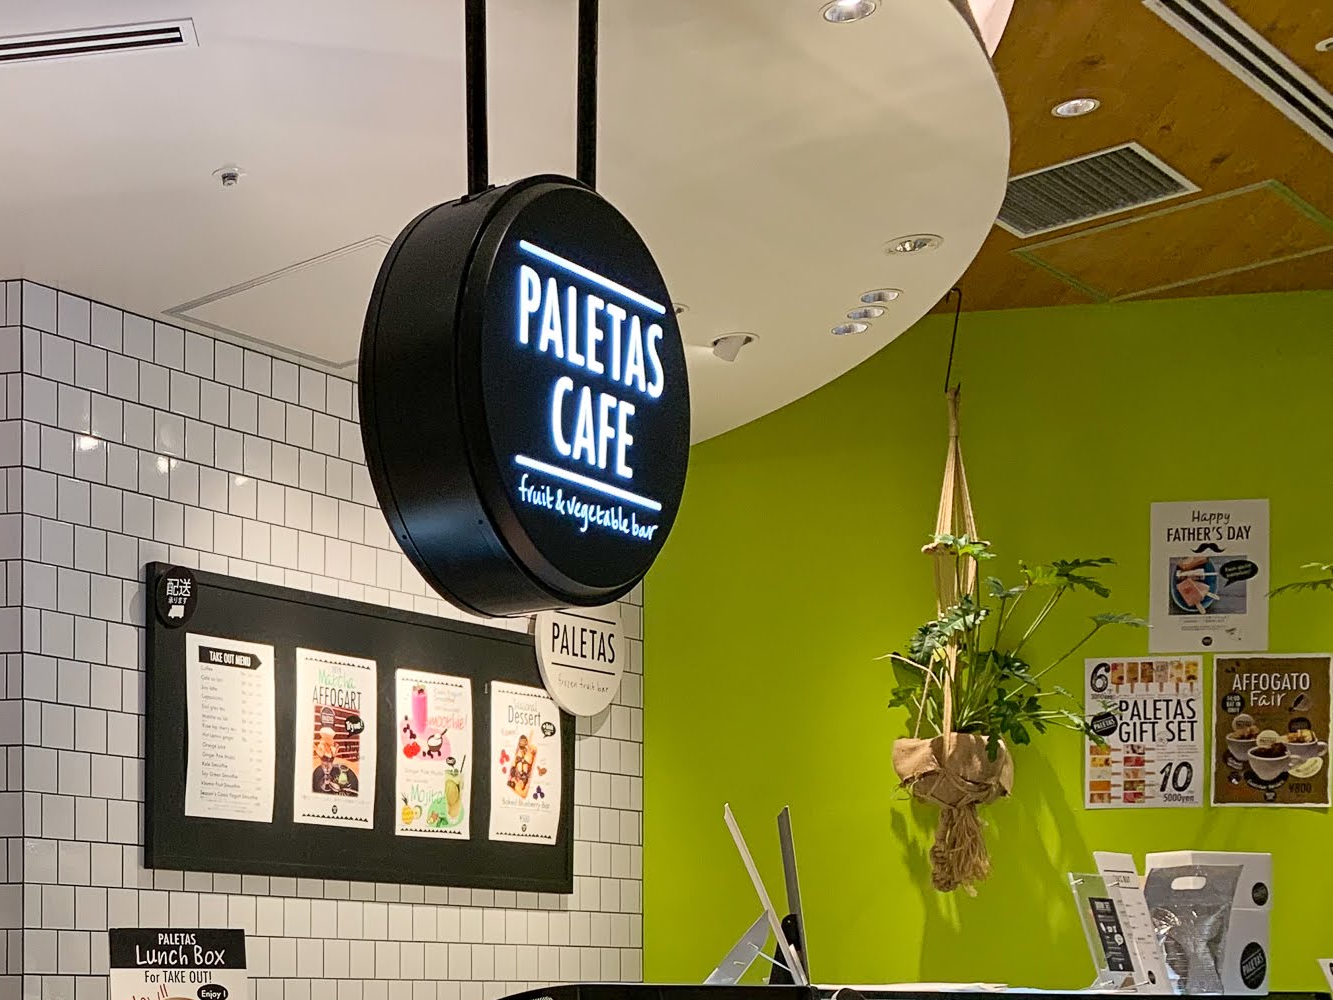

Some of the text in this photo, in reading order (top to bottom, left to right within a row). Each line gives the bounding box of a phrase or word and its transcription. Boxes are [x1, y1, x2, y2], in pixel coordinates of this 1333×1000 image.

[518, 264, 666, 399] PALETAS
[552, 376, 636, 479] CAFE
[519, 473, 554, 509] fruit
[567, 498, 630, 534] vegetable
[631, 513, 658, 541] bar
[1192, 510, 1231, 525] Happy
[1167, 525, 1252, 542] FATHER'S DAY
[166, 578, 192, 597] 配送
[551, 622, 615, 664] PALETAS
[209, 651, 223, 663] TAKE
[224, 653, 235, 665] OUT
[1090, 662, 1111, 693] 6
[1232, 672, 1310, 691] AFFOGATO
[313, 686, 362, 710] AFFOGART
[1250, 690, 1286, 707] Fair
[507, 705, 541, 727] Dessert
[1119, 698, 1196, 721] PALETAS
[1119, 720, 1197, 743] GIFT SET
[1159, 761, 1193, 792] 10
[158, 933, 197, 945] PALETAS
[135, 944, 226, 965] Lunch Box
[144, 970, 212, 984] For TAKE OUT!
